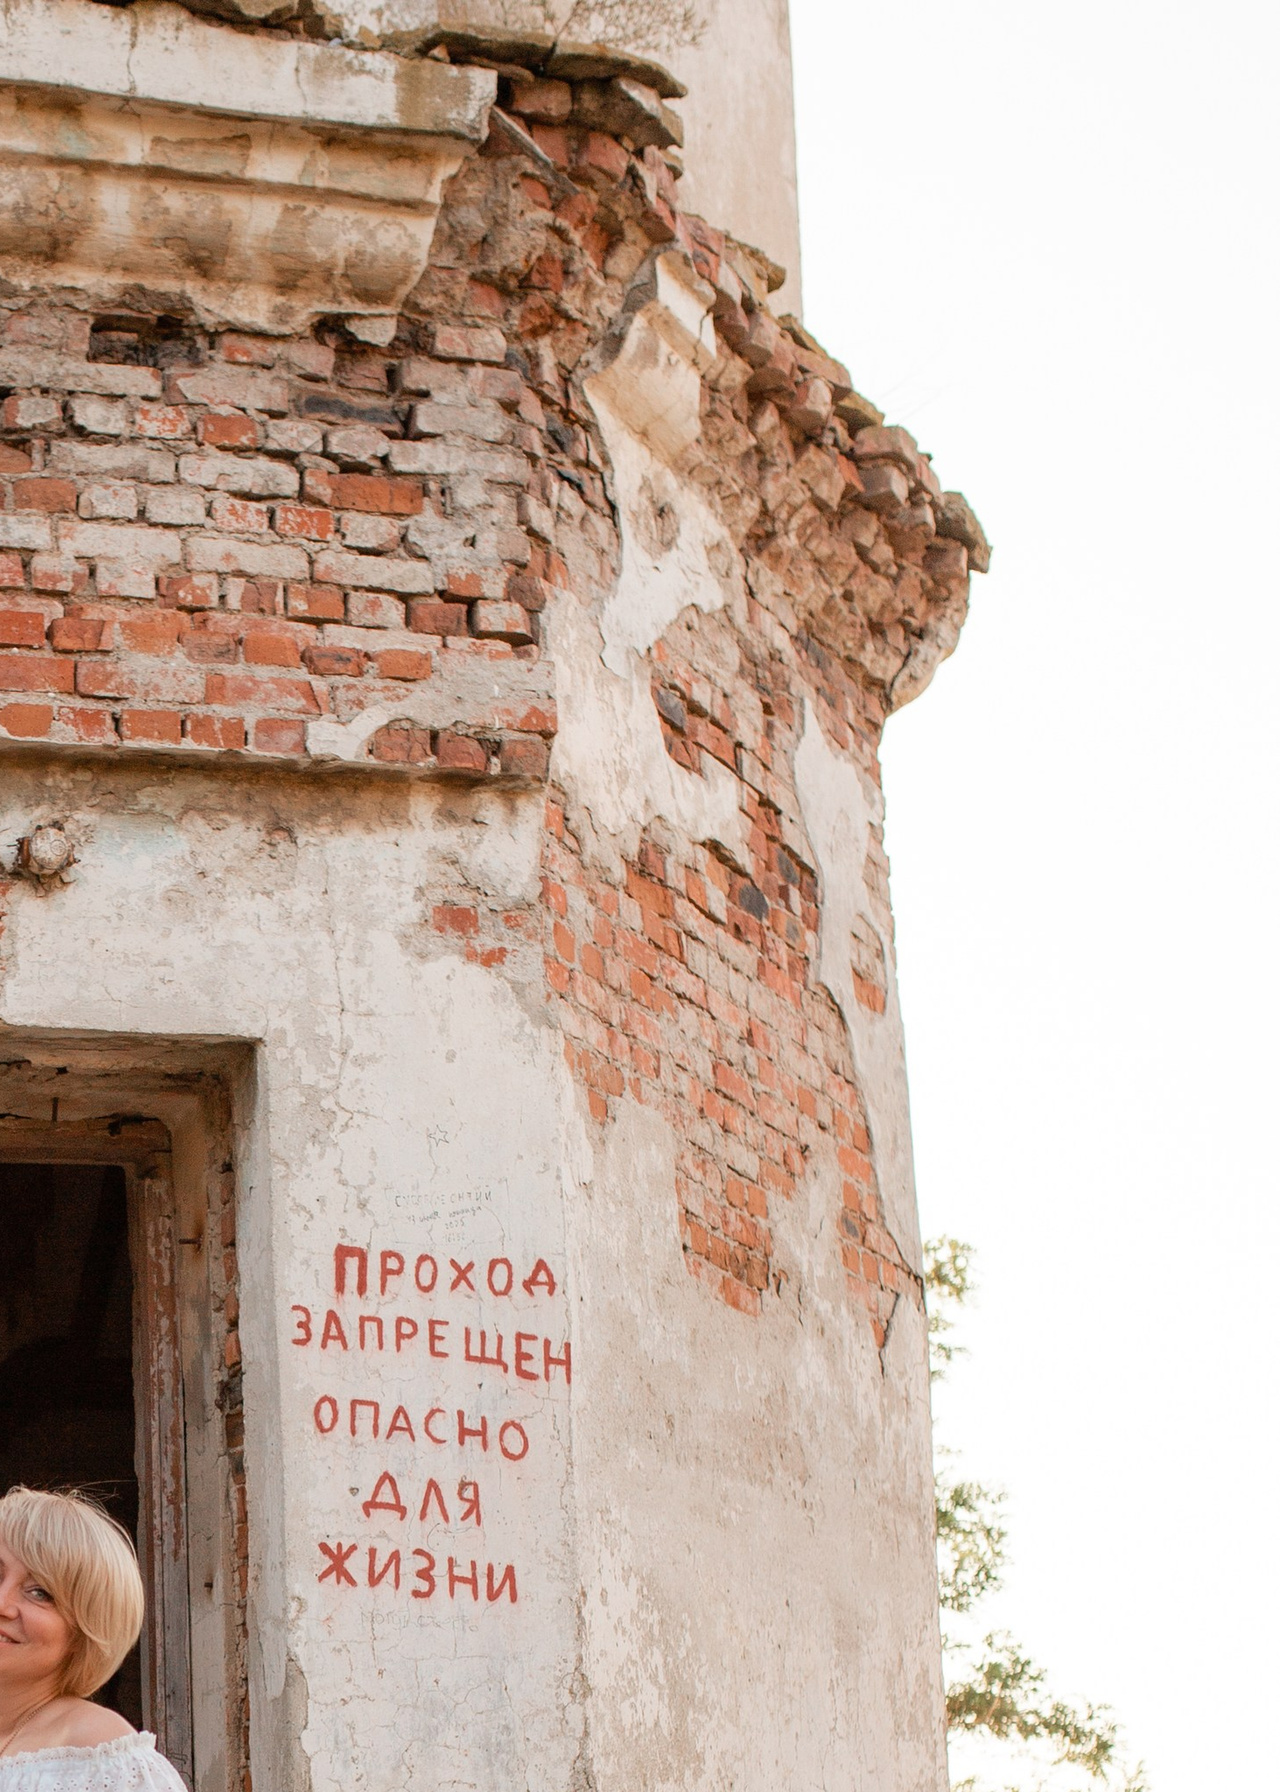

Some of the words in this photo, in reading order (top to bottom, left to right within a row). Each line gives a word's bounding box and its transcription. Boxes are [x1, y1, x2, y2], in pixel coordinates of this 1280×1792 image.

[333, 1243, 557, 1298] ПРОХОД
[291, 1304, 572, 1386] ЗАПРЕЩЕН
[313, 1395, 529, 1462] ОПАСНО
[361, 1470, 483, 1527] ДЛЯ
[317, 1541, 518, 1604] ЖИЗНИ
